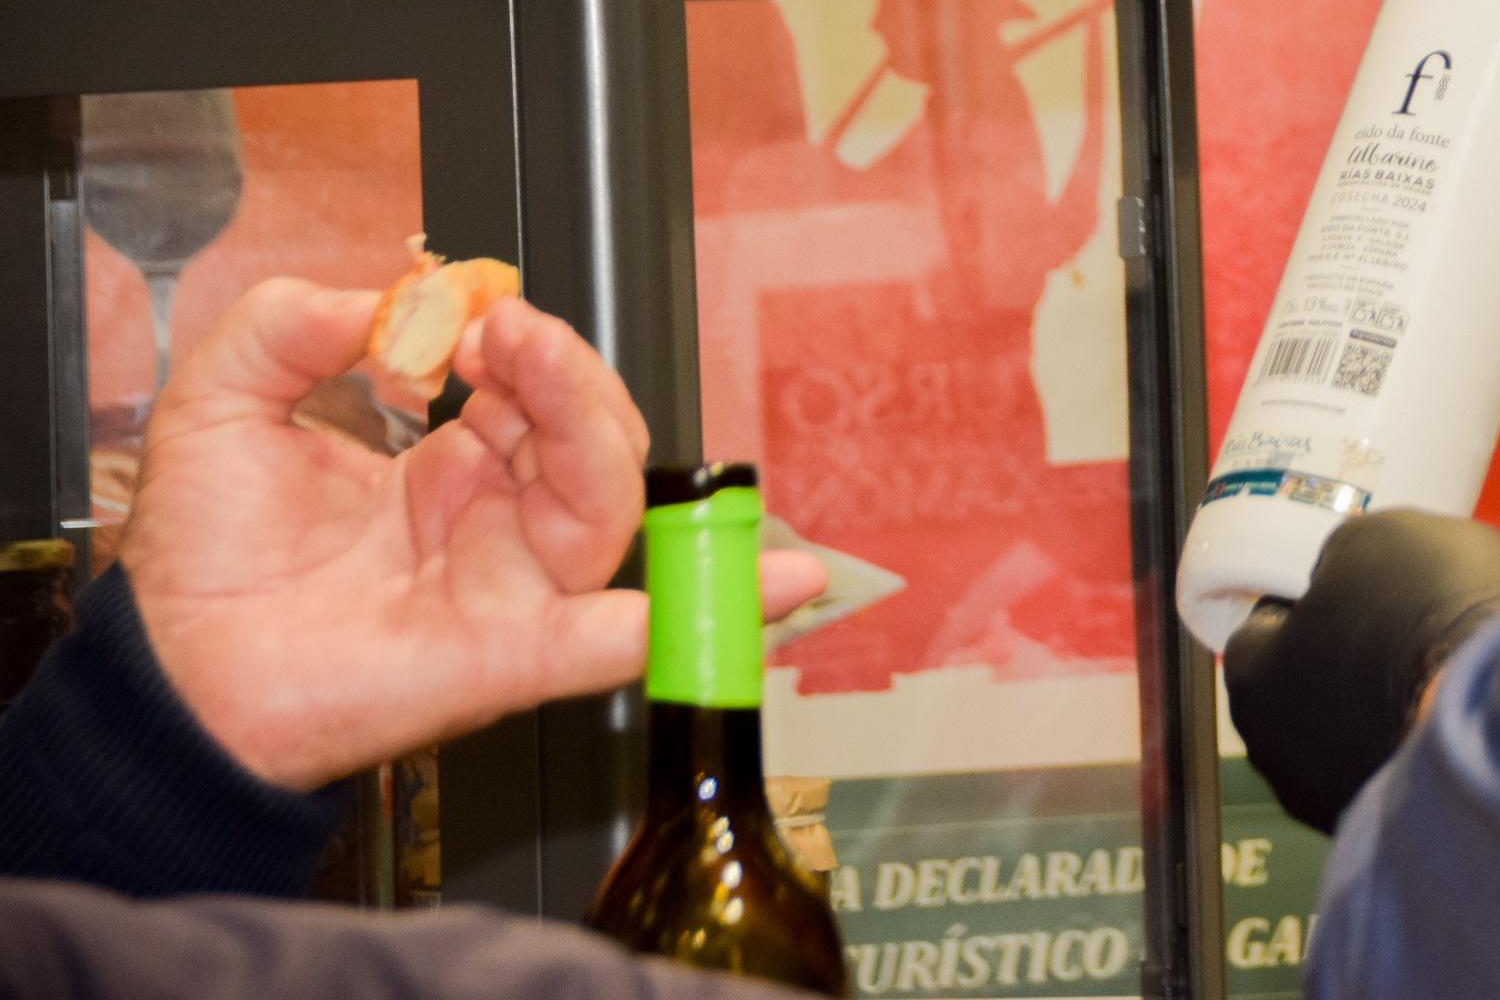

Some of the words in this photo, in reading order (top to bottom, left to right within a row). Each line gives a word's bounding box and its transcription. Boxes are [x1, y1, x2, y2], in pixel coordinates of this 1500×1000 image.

[1386, 123, 1405, 140] da
[1409, 126, 1451, 149] fonte
[1374, 169, 1436, 190] BAIXAS
[1392, 194, 1428, 212] 2024
[873, 846, 1144, 911] DECLARAD
